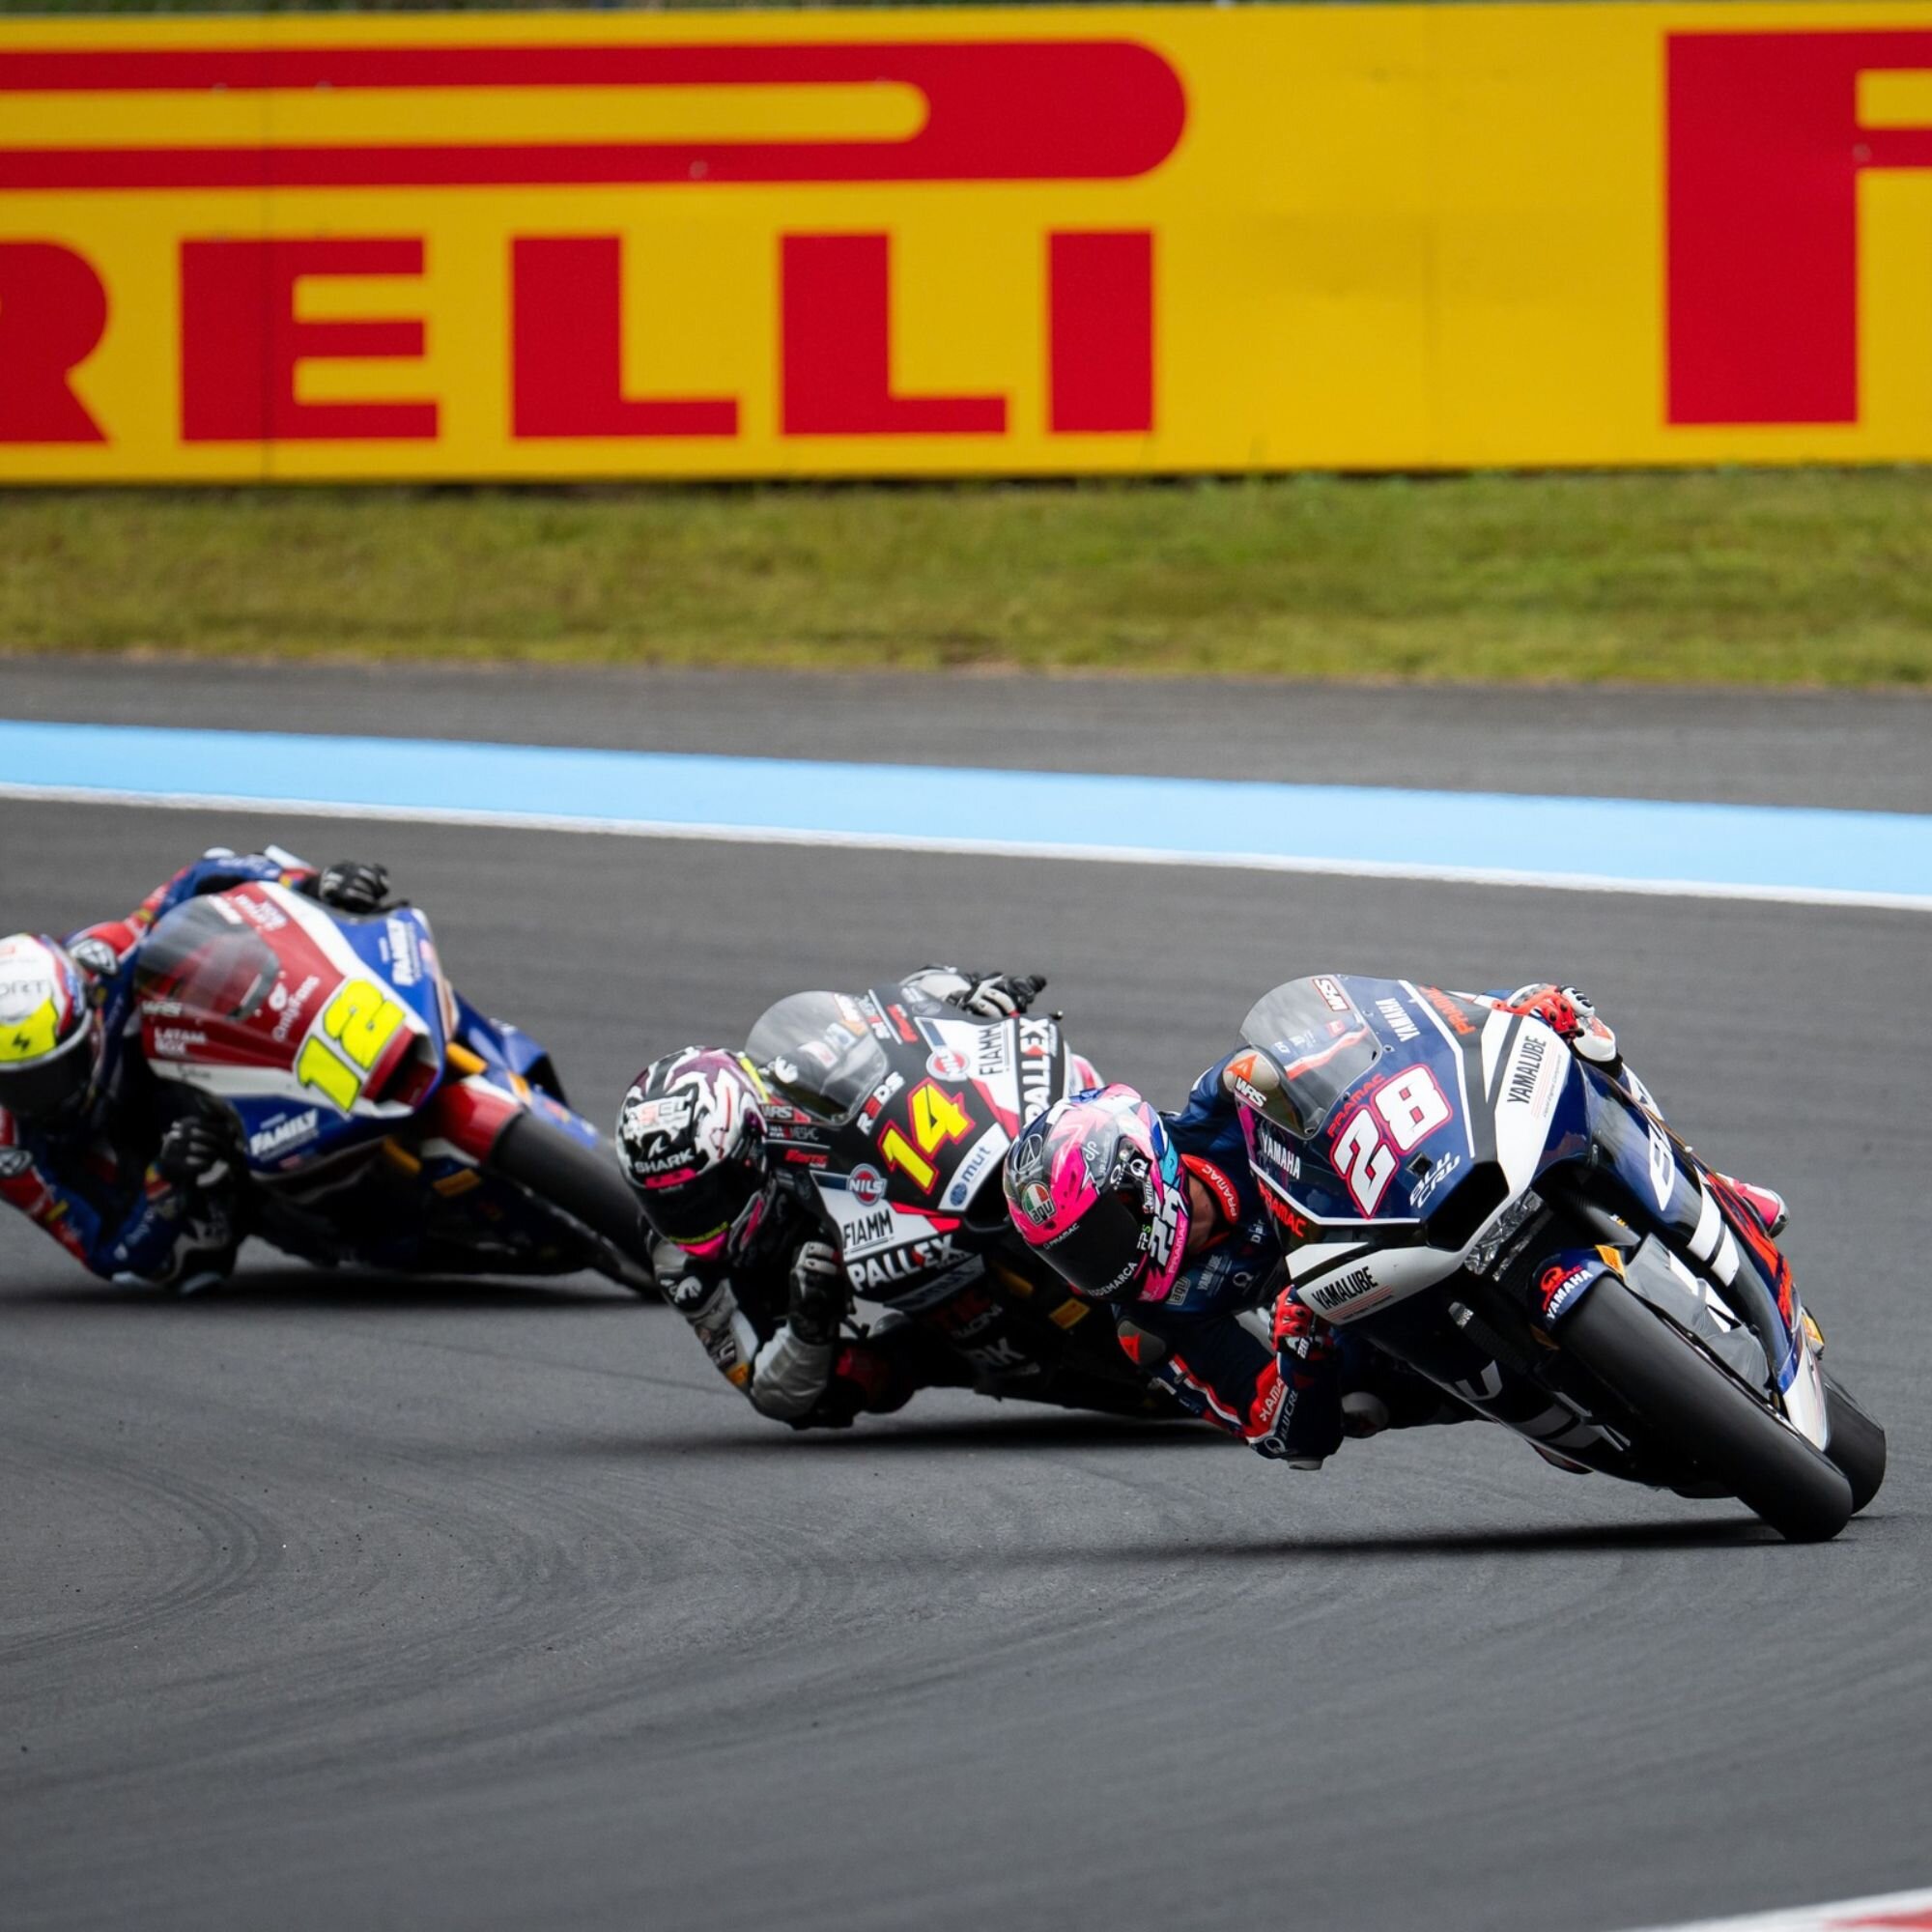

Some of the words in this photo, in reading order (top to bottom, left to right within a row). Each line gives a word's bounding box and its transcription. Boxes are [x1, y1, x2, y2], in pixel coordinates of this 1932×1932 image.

[297, 980, 405, 1112] 12
[979, 1022, 1004, 1075] FIAMM
[1019, 1017, 1052, 1127] PALLEX
[1507, 1036, 1548, 1104] YAMALUBE
[1236, 1076, 1267, 1107] WRS
[1326, 1073, 1388, 1137] PRAMAC
[250, 1109, 318, 1157] FAMILY
[878, 1080, 973, 1192] 14
[1262, 1133, 1301, 1180] YAMAHA
[1331, 1065, 1452, 1219] 28
[635, 1149, 695, 1175] SHARK
[849, 1178, 886, 1197] NILS
[1201, 1163, 1238, 1217] PRAMAC
[1260, 1186, 1307, 1237] PRAMAC
[842, 1208, 895, 1250] FIAMM
[846, 1235, 963, 1292] PALLEX
[1311, 1265, 1378, 1311] YAMALUBE
[1546, 1268, 1595, 1321] YAMAHA
